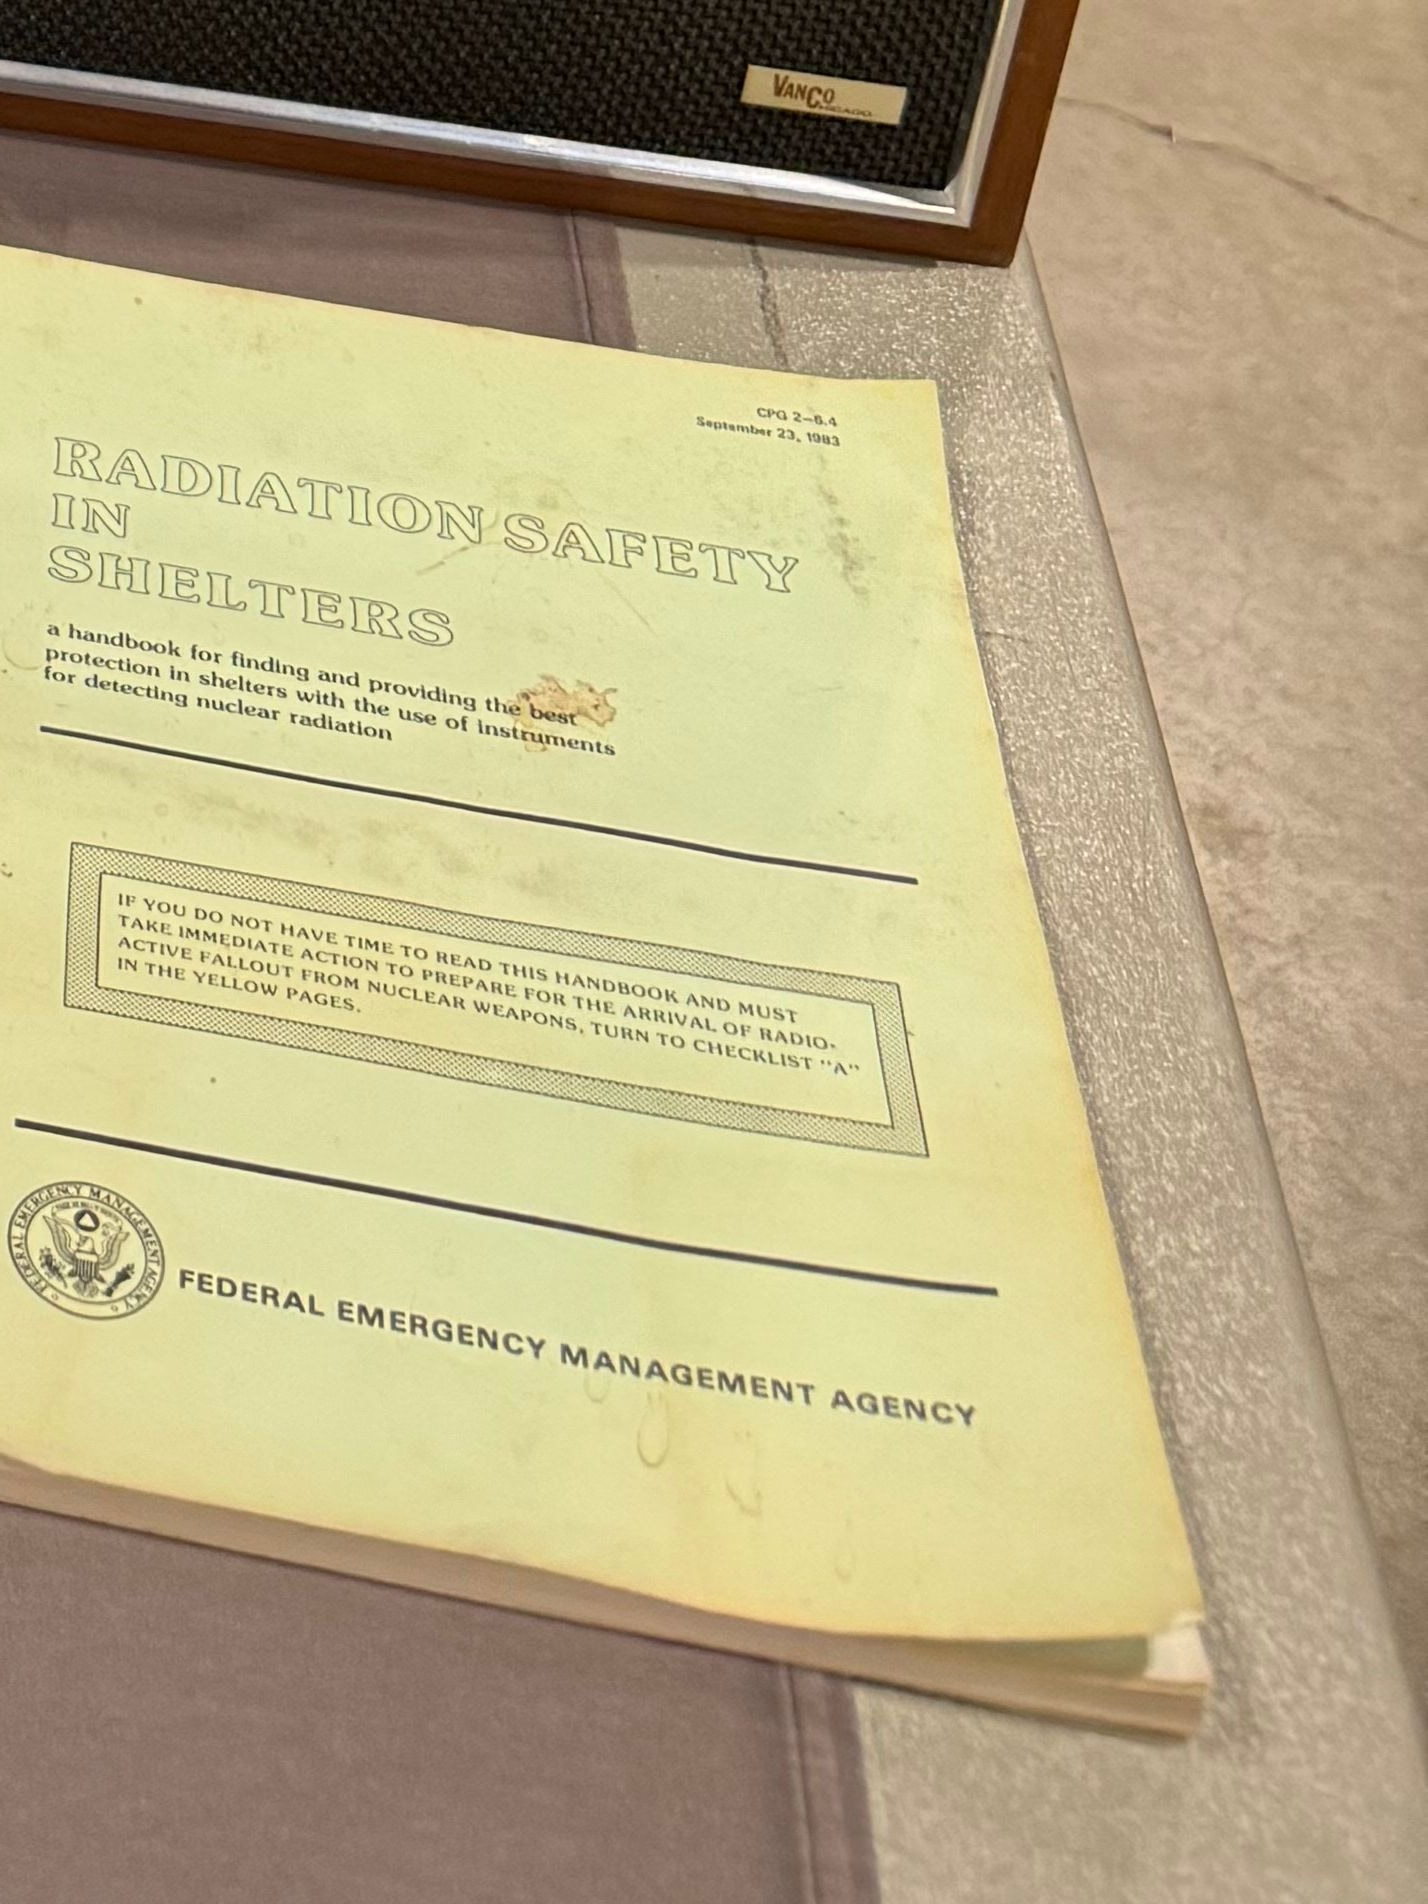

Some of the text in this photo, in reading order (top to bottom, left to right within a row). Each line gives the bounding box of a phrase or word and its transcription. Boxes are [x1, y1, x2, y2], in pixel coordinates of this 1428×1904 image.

[696, 415, 841, 447] September 23, 1983
[756, 407, 788, 422] CPG
[51, 492, 131, 539] IN
[53, 436, 800, 593] RADIATION SAFETY
[47, 544, 455, 648] SHELTERS
[44, 665, 393, 741] for detecting nuclear radiation
[45, 646, 616, 757] protection in shelters with the use of instruments
[46, 623, 578, 727] a handbook for finding and providing the best
[117, 892, 798, 1024] IF YOU DO NOT HAVE TIME TO READ THIS HANDBOOK AND MUST
[117, 956, 362, 1014] IN THE YELLOW PAGES.
[118, 936, 193, 961] ACTIVE
[199, 950, 295, 979] FALLOUT
[300, 968, 360, 991] FROM
[367, 979, 466, 1011] NUCLEAR
[473, 1001, 585, 1035] WEAPONS,
[589, 1020, 649, 1044] TURN
[655, 1032, 686, 1050] TO
[692, 1038, 813, 1071] CHECKLIST
[119, 914, 837, 1052] TAKE IMMEDIATE ACTION TO PREPARE FOR THE ARRIVAL OF RADIO-
[178, 1267, 978, 1428] FEDERAL EMERGENCY MANAGEMENT AGENCY
